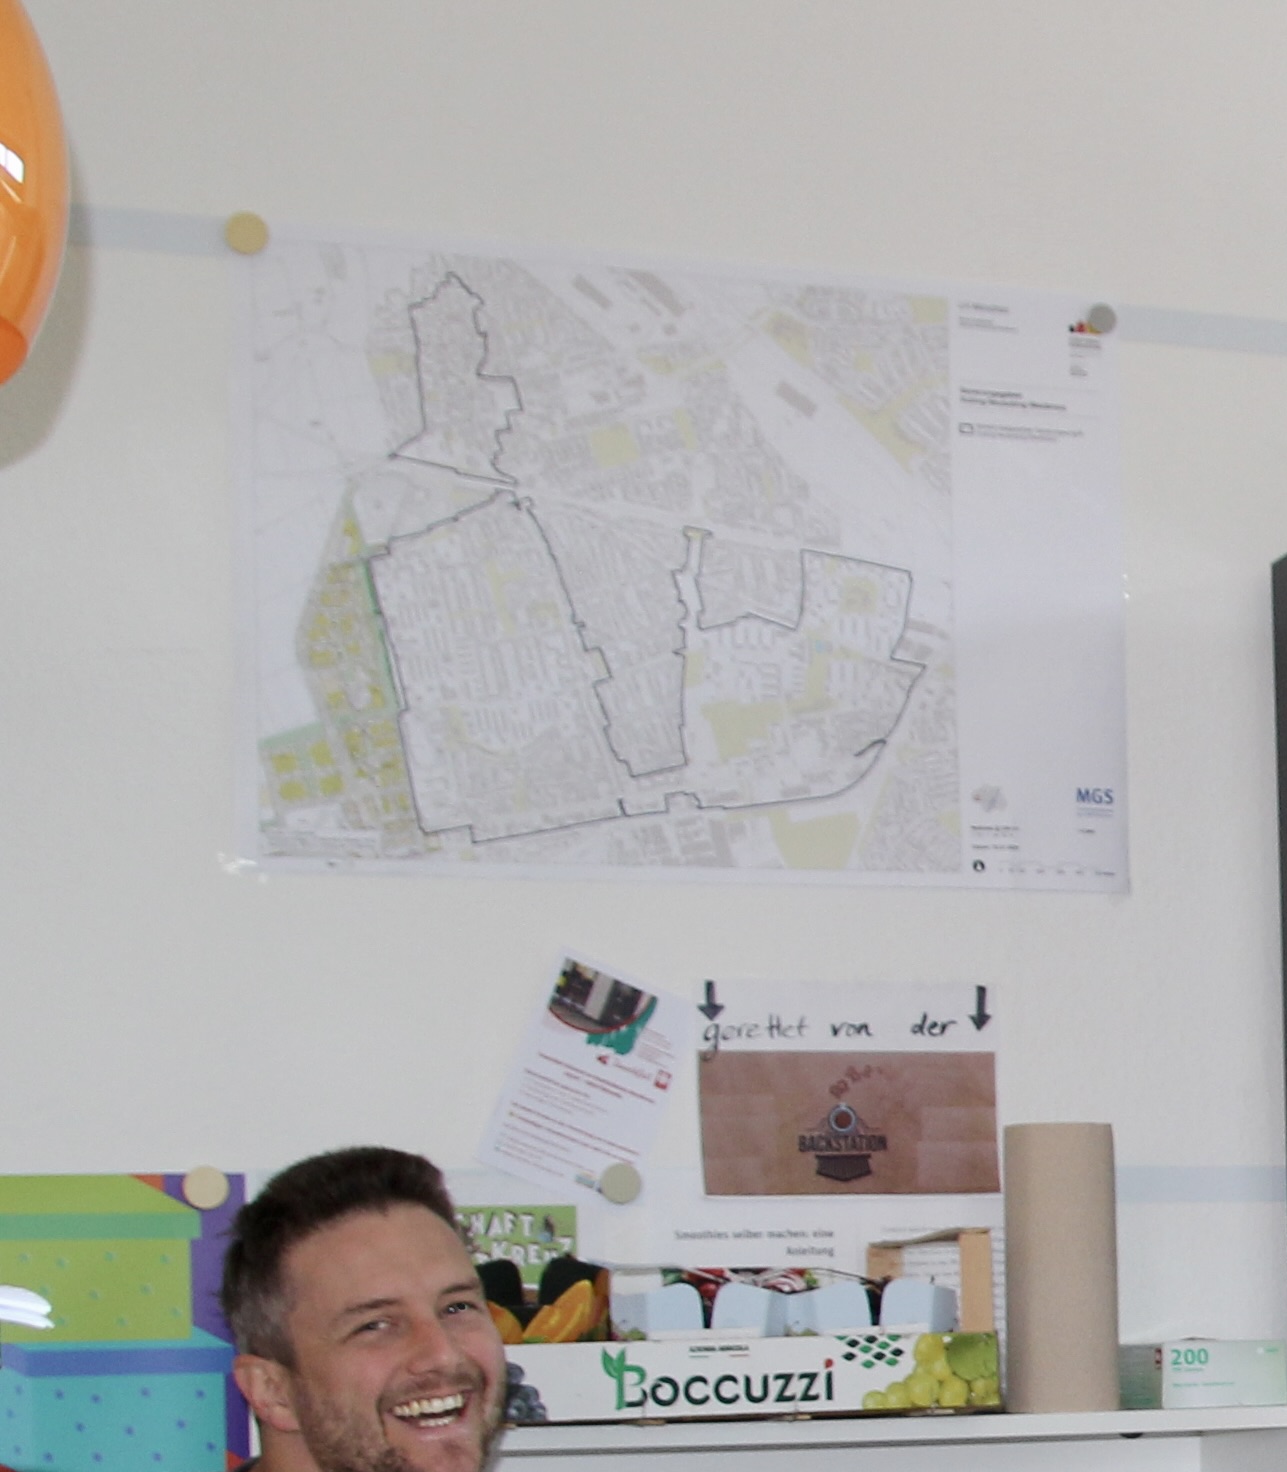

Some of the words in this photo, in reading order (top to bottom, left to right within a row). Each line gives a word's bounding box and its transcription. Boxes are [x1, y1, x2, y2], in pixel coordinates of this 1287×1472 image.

[1076, 787, 1115, 804] MGS
[829, 1020, 873, 1037] von
[910, 1011, 958, 1037] der
[798, 1134, 888, 1152] BACKSTATION
[1170, 1348, 1209, 1366] 200
